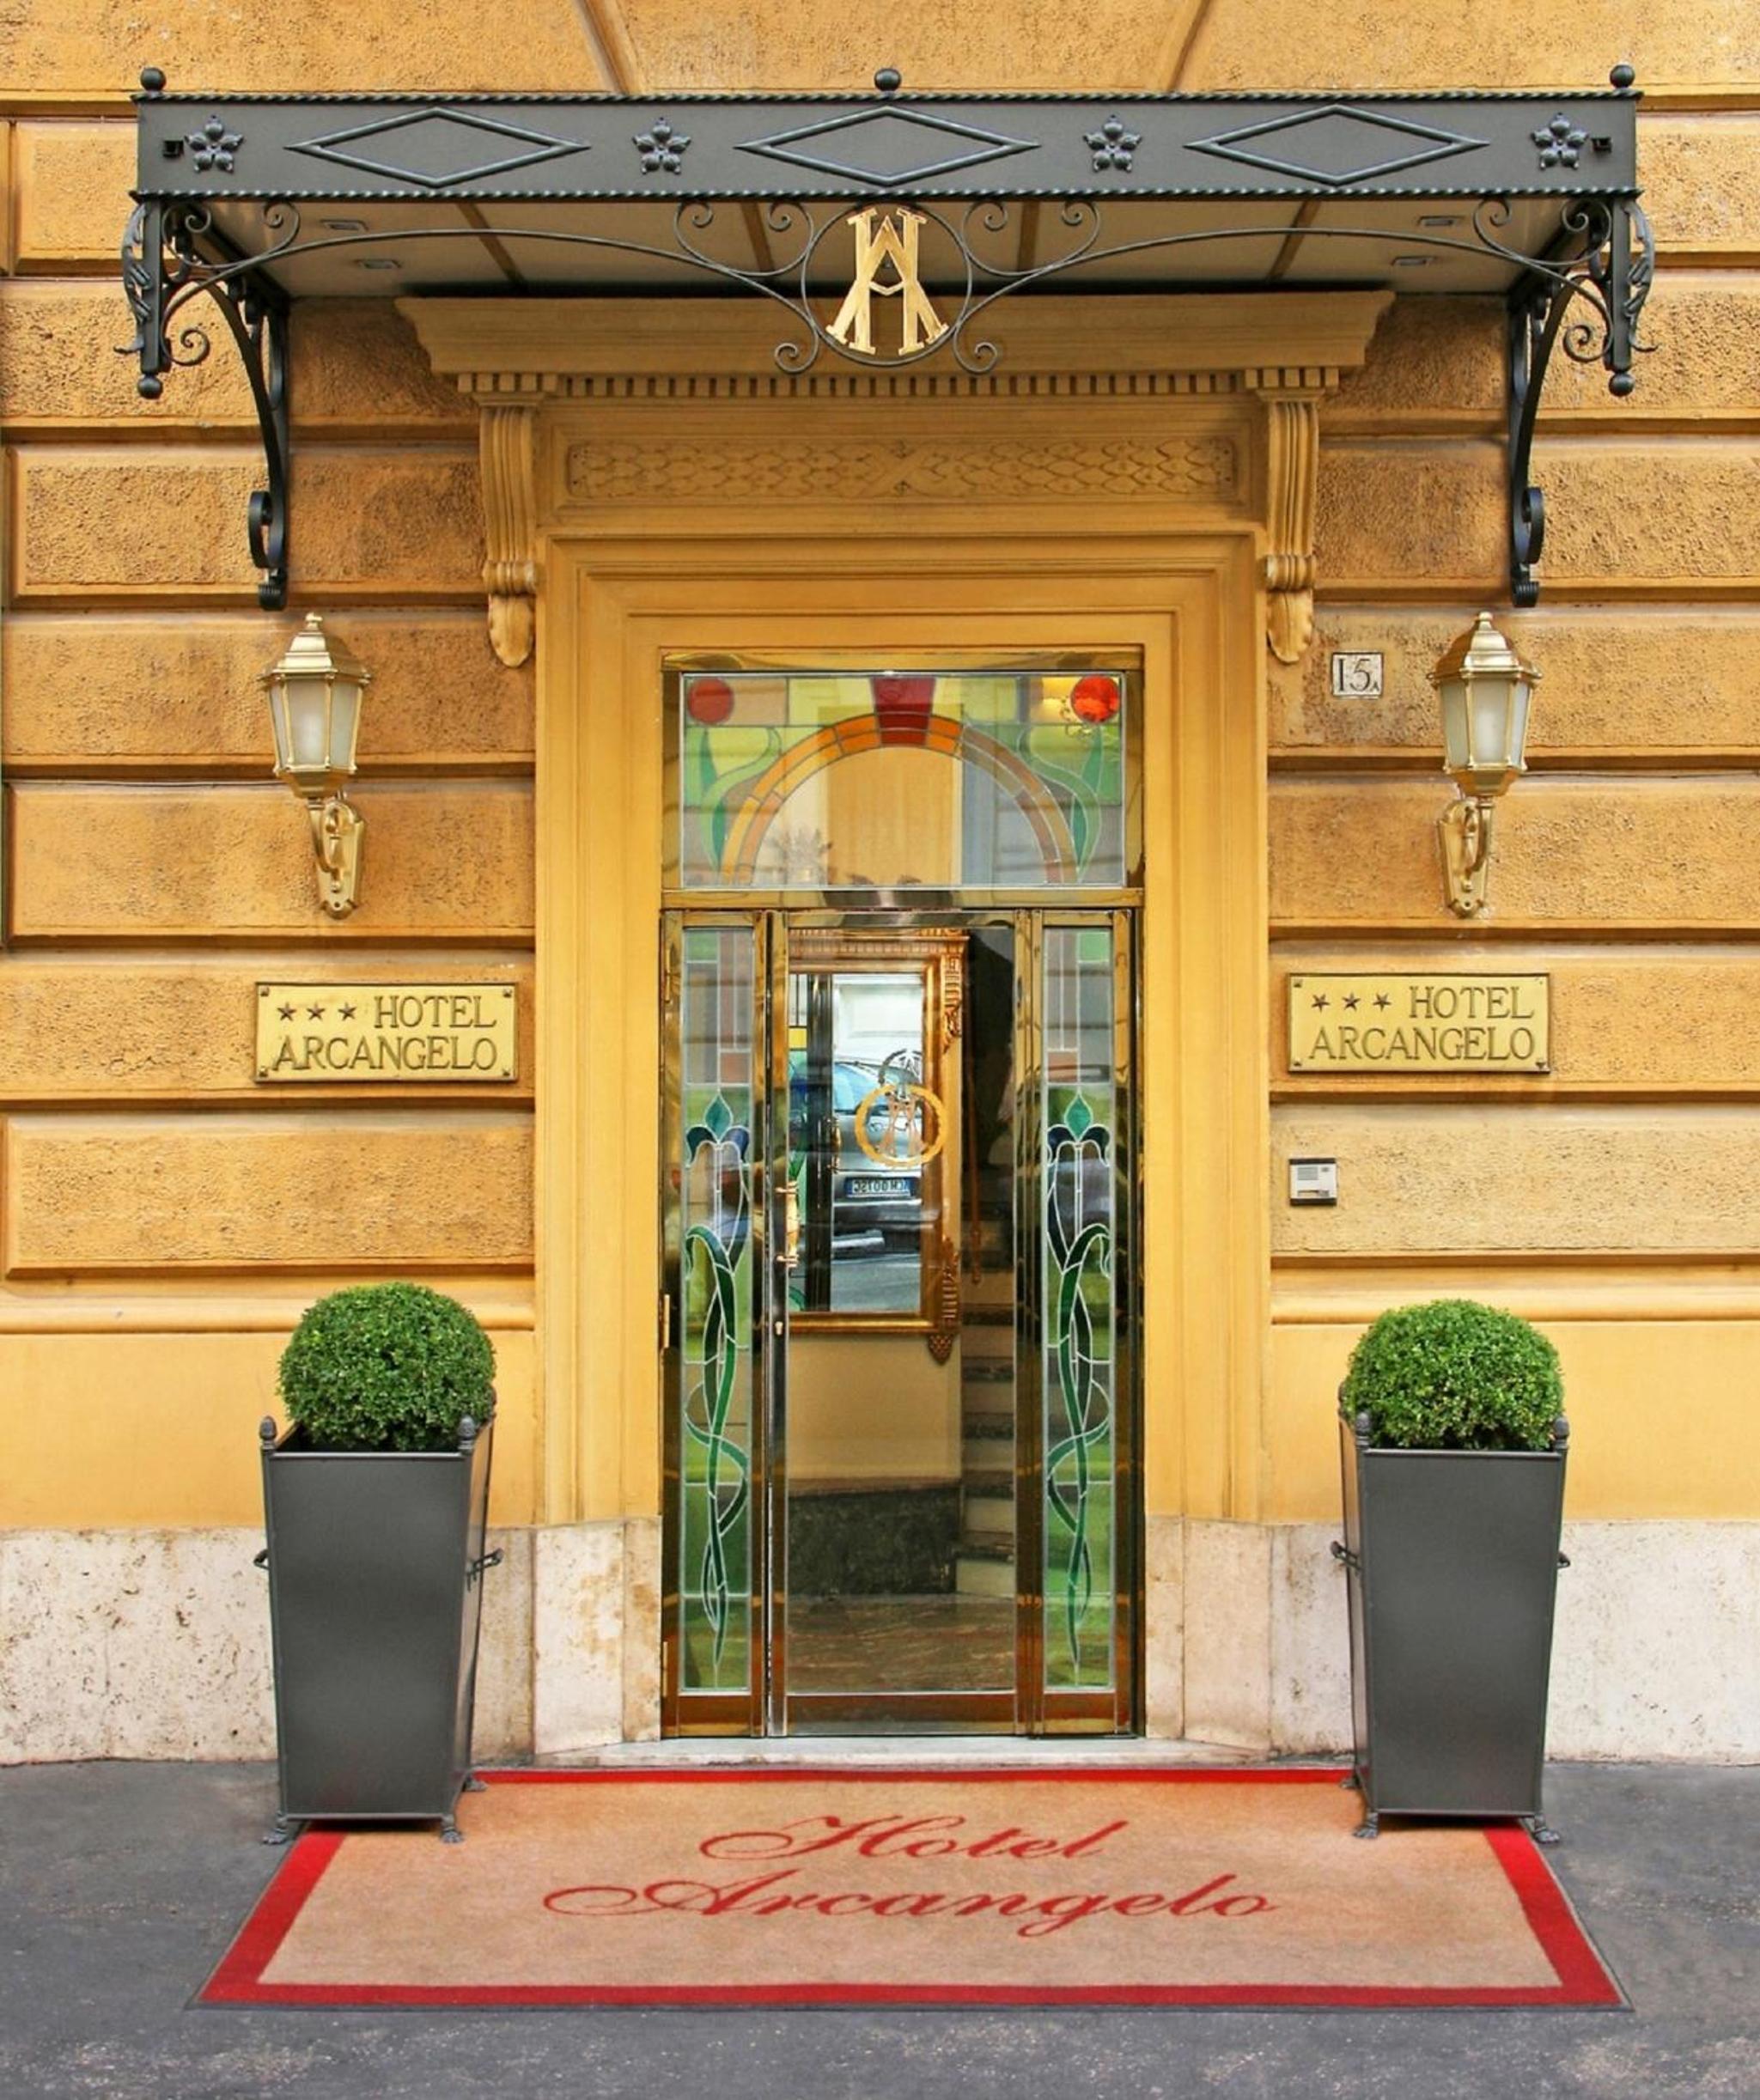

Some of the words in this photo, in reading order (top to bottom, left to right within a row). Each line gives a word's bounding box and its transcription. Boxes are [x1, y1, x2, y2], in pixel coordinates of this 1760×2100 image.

[374, 995, 497, 1029] HOTEL
[1409, 986, 1535, 1020] HOTEL
[271, 1035, 498, 1071] ARCANGELO
[1308, 1026, 1536, 1061] ARCANGELO
[699, 1815, 1129, 1860] Hotel
[543, 1867, 1280, 1938] Arcangelo
